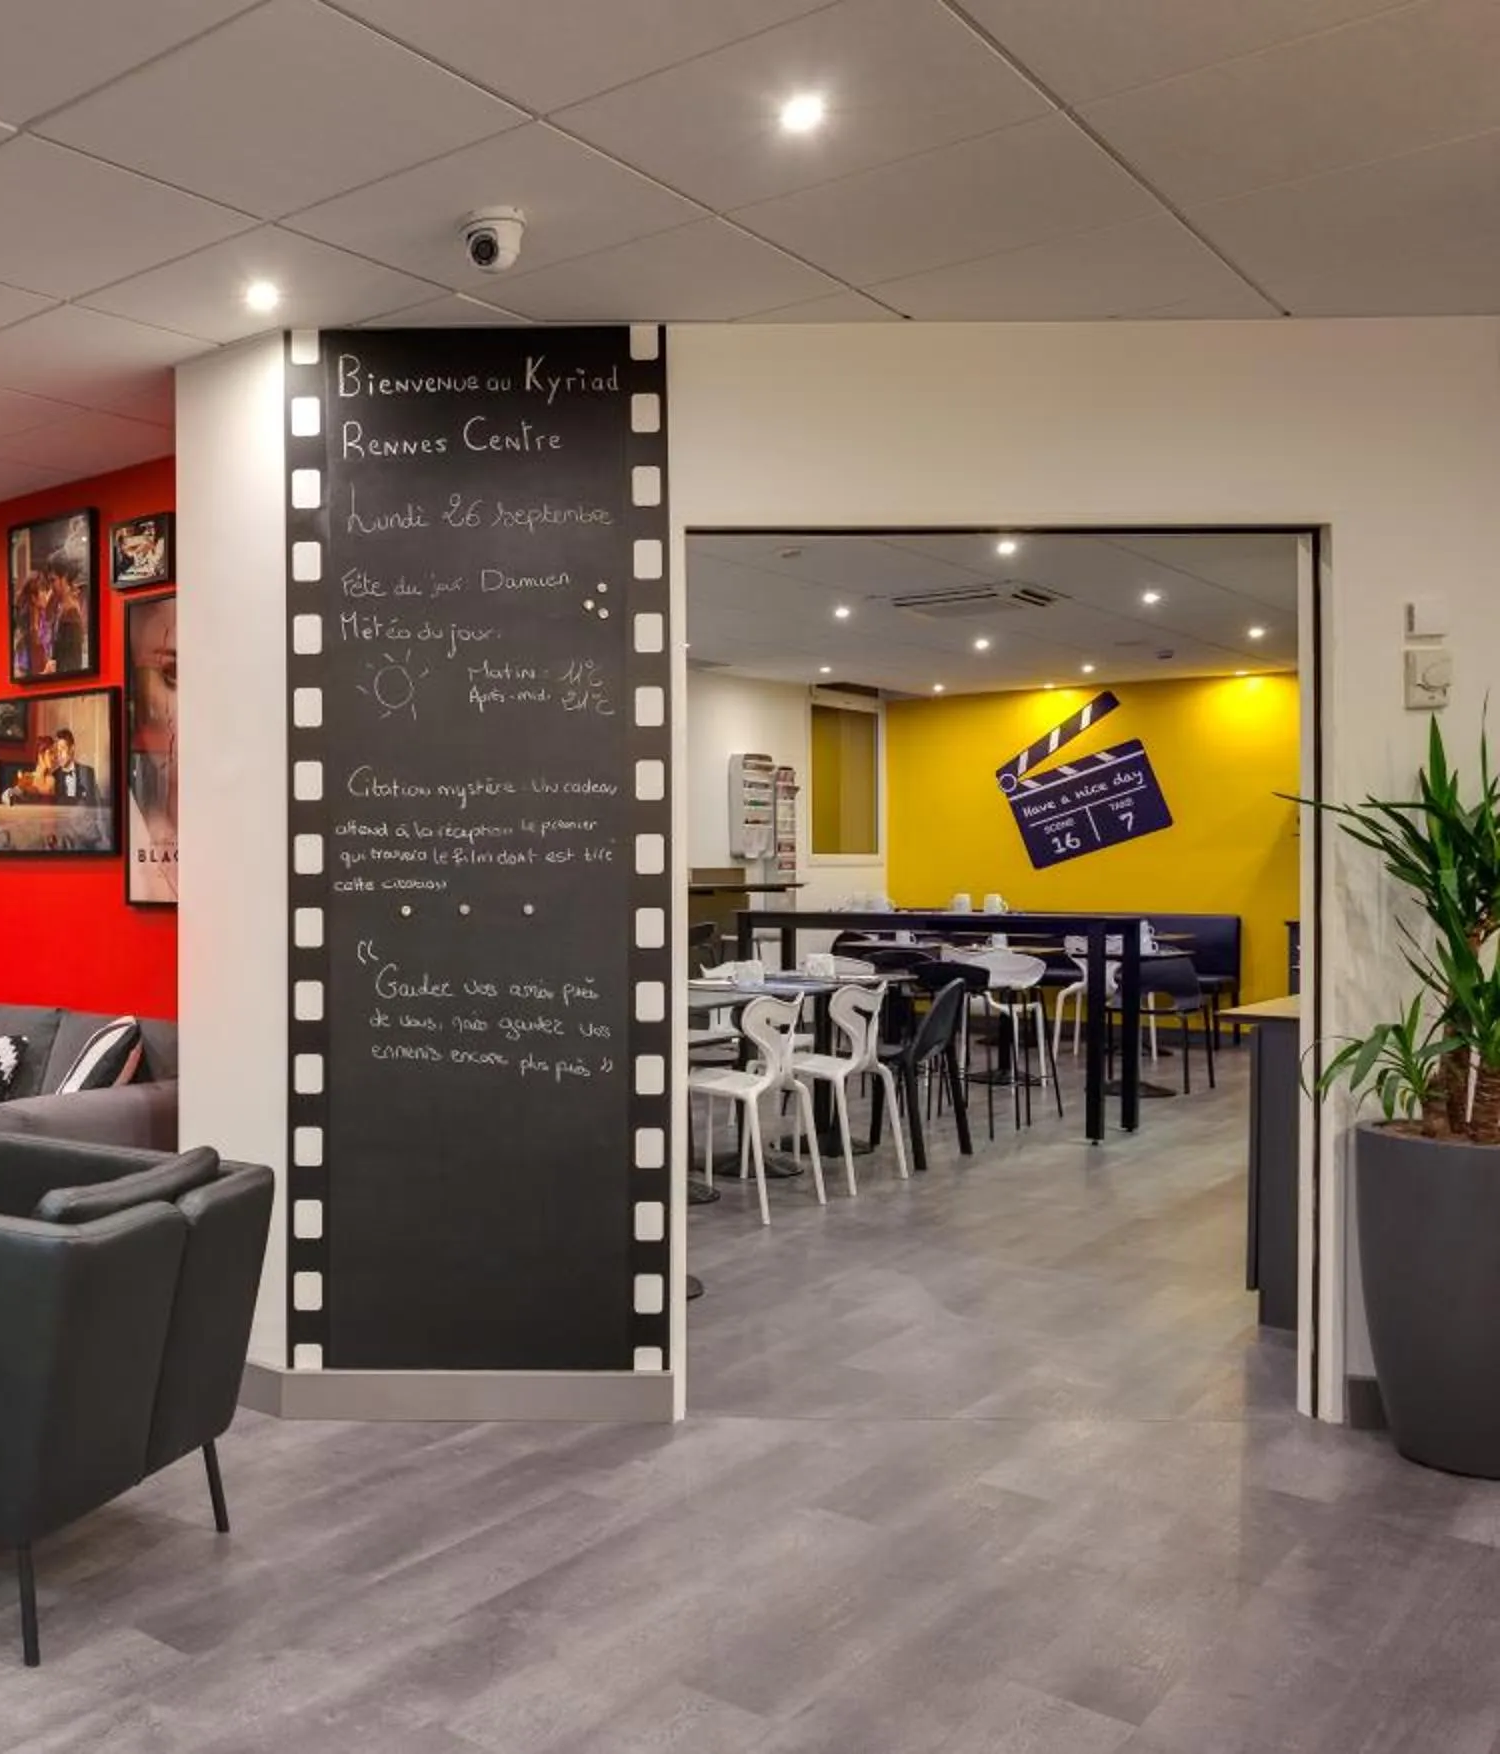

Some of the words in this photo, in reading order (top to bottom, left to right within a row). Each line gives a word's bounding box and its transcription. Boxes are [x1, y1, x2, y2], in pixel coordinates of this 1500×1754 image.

[339, 353, 479, 397] Bienvenue
[487, 376, 511, 391] au
[525, 355, 619, 405] Kyriad
[343, 420, 448, 459] Rennes
[463, 415, 563, 451] Centre
[347, 481, 430, 533] Lundi
[441, 493, 484, 527] 26
[340, 567, 388, 598] Fête
[394, 576, 423, 596] du
[481, 568, 571, 592] Damien
[340, 610, 412, 641] Météo
[417, 621, 444, 641] du
[347, 764, 432, 798] Citation
[563, 777, 619, 796] cadeau
[1022, 801, 1057, 818] Have
[1061, 794, 1071, 804] a
[1074, 782, 1109, 800] nice
[1112, 769, 1145, 786] day
[335, 820, 389, 838] attend
[395, 823, 410, 839] à
[412, 820, 434, 839] la
[541, 818, 598, 838] premier
[1043, 817, 1077, 835] SCENE
[1118, 811, 1134, 832] 7
[340, 850, 366, 869] qui
[433, 846, 449, 865] le
[451, 848, 494, 867] film
[496, 848, 538, 866] dont
[545, 847, 574, 863] est
[1051, 832, 1082, 855] 16
[333, 876, 376, 892] cette
[375, 963, 454, 999] Gardez
[463, 979, 498, 998] vos
[369, 1007, 391, 1028] de
[498, 1016, 566, 1041] gardez
[579, 1022, 611, 1039] vos
[371, 1044, 442, 1061] ennemis
[450, 1048, 510, 1065] encore
[520, 1052, 550, 1077] plus
